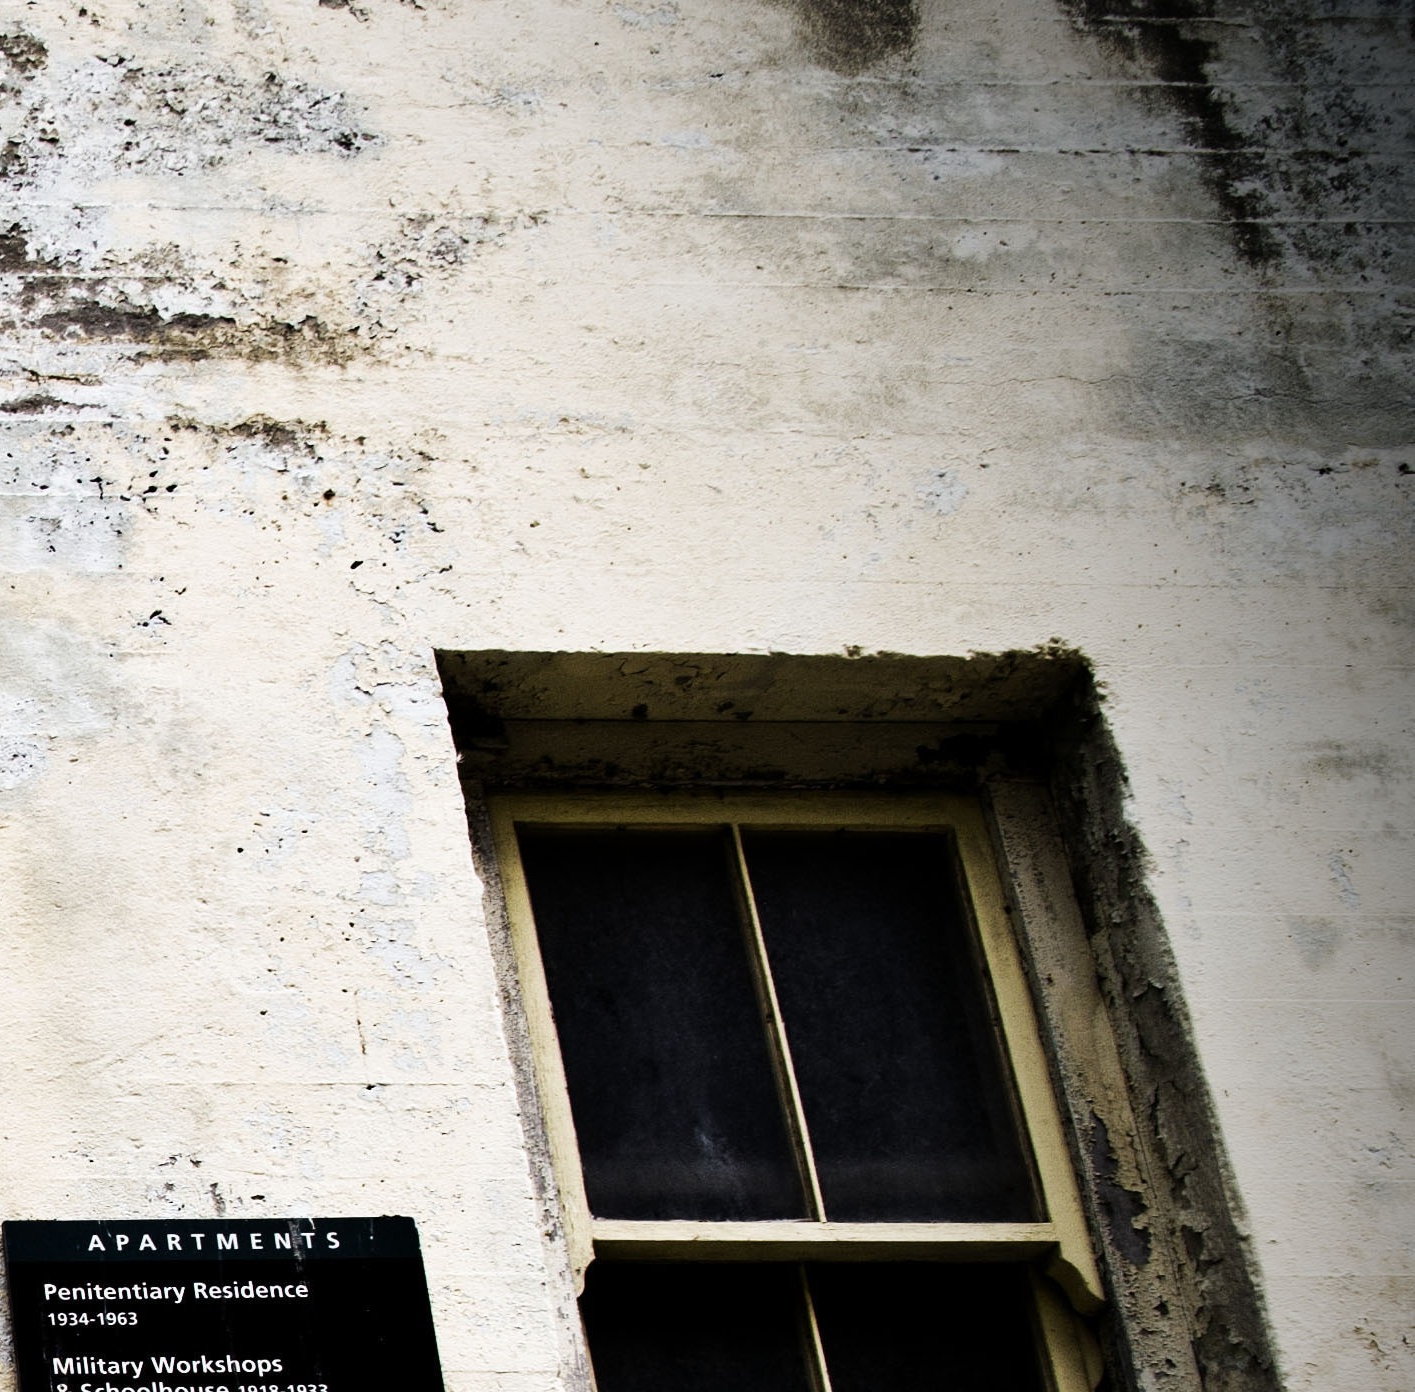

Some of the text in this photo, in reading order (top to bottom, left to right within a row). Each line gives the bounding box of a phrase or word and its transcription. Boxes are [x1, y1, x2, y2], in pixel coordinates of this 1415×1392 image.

[88, 1232, 341, 1252] APARTMENTS
[43, 1280, 309, 1303] Penitentiary Residence
[47, 1311, 138, 1327] 1934-1963
[52, 1354, 283, 1378] Military Workshops
